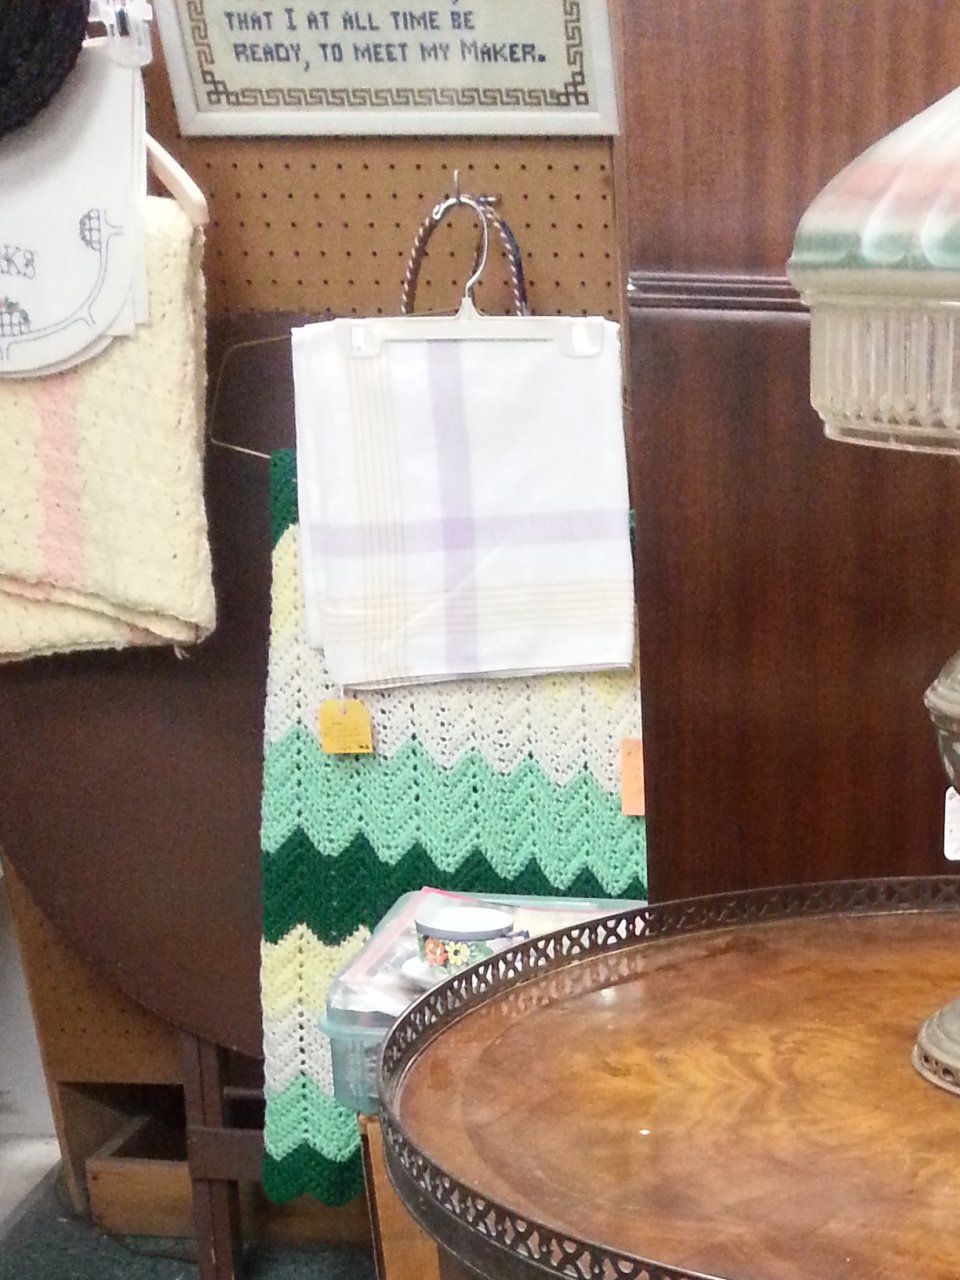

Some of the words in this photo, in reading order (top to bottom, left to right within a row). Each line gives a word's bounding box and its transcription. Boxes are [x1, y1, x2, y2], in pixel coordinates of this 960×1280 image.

[224, 10, 273, 31] THAT
[285, 8, 298, 31] I
[306, 10, 330, 31] AT
[342, 10, 380, 31] ALL
[390, 10, 440, 31] TIME
[450, 10, 475, 31] BE
[233, 41, 311, 72] READY,
[318, 42, 344, 63] TO
[353, 42, 408, 63] MEET
[420, 42, 450, 62] MY
[460, 38, 546, 63] MAKER.
